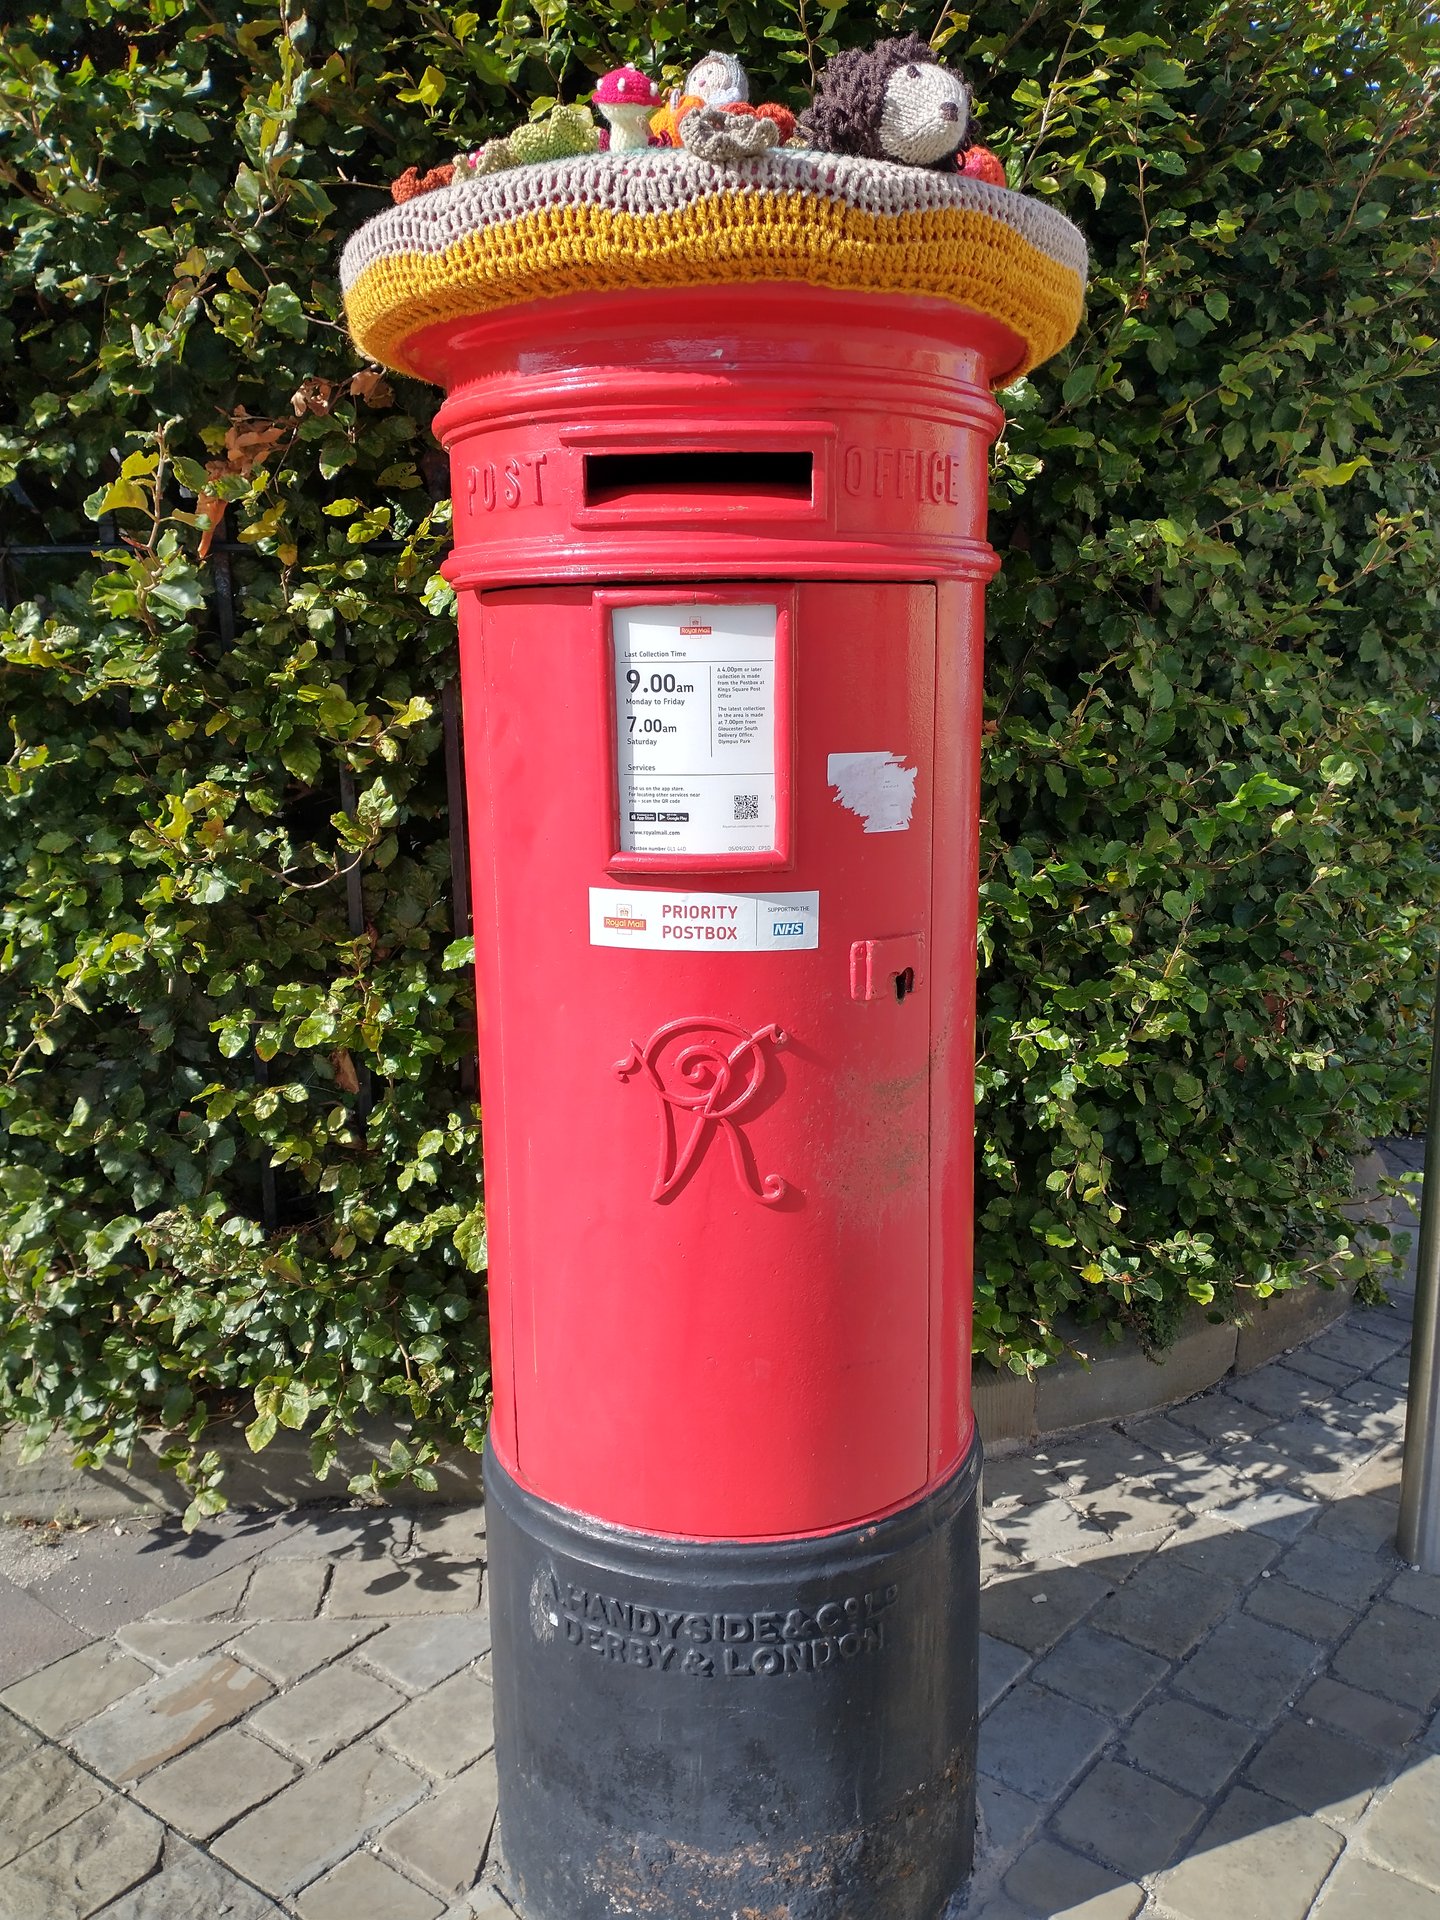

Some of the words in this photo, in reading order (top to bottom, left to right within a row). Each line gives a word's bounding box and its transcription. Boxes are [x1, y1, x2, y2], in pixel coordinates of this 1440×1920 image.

[844, 444, 960, 505] OFFICE
[464, 452, 548, 517] POST
[626, 669, 694, 693] 9.00am
[626, 698, 652, 706] Monday
[664, 698, 685, 706] Friday
[626, 716, 677, 733] 7.00am
[627, 738, 658, 746] Saturday
[662, 904, 738, 920] PRIORITY
[605, 918, 626, 928] Royal
[628, 920, 645, 928] Mail
[774, 923, 802, 936] NHS
[662, 925, 738, 940] POSTBOX
[562, 1613, 677, 1671] DERBY
[681, 1648, 715, 1678] &
[723, 1622, 884, 1677] LONDON
